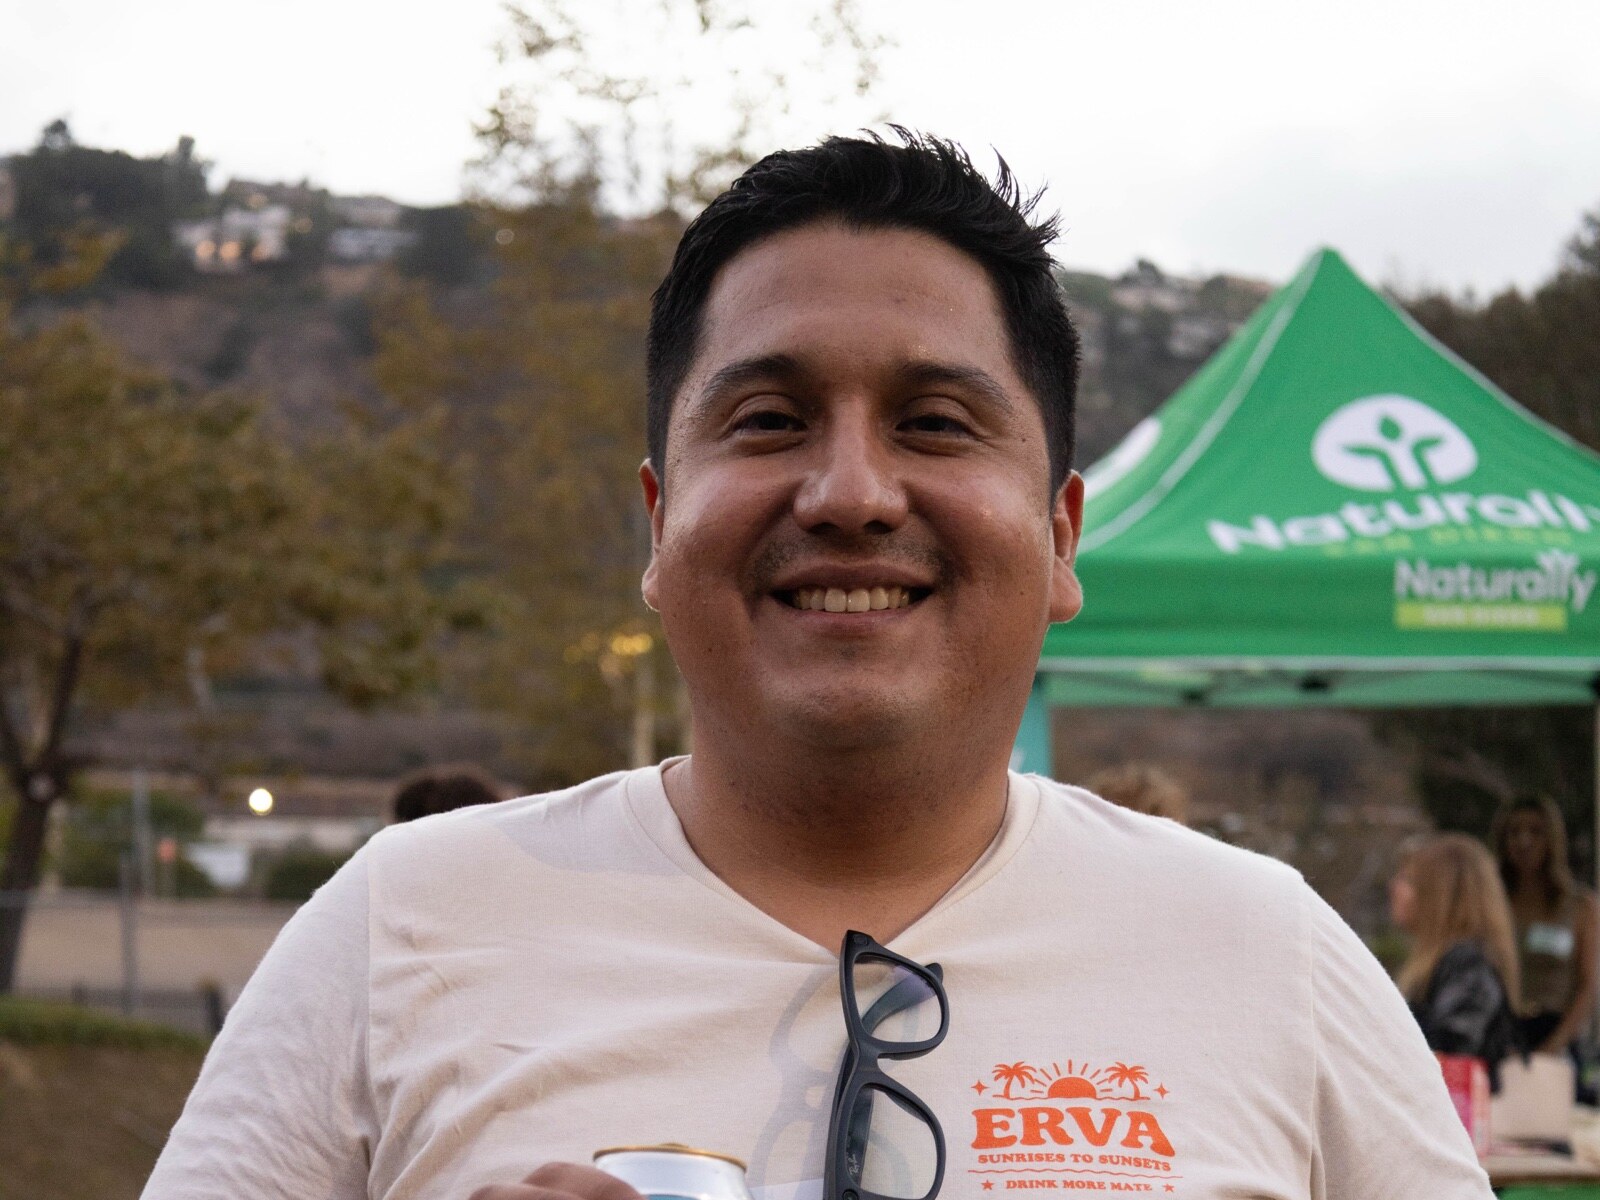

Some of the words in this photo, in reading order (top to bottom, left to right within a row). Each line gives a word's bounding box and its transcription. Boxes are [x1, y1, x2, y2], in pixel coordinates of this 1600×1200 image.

[1206, 489, 1600, 554] Naturall
[1396, 551, 1596, 613] Naturally
[970, 1106, 1176, 1157] ERVA
[977, 1153, 1066, 1164] SUNRISES
[1070, 1153, 1094, 1164] TO
[1099, 1155, 1172, 1172] SUNSETS
[1005, 1179, 1058, 1190] DRINK
[1062, 1180, 1107, 1191] MORE
[1110, 1182, 1153, 1192] MATE
